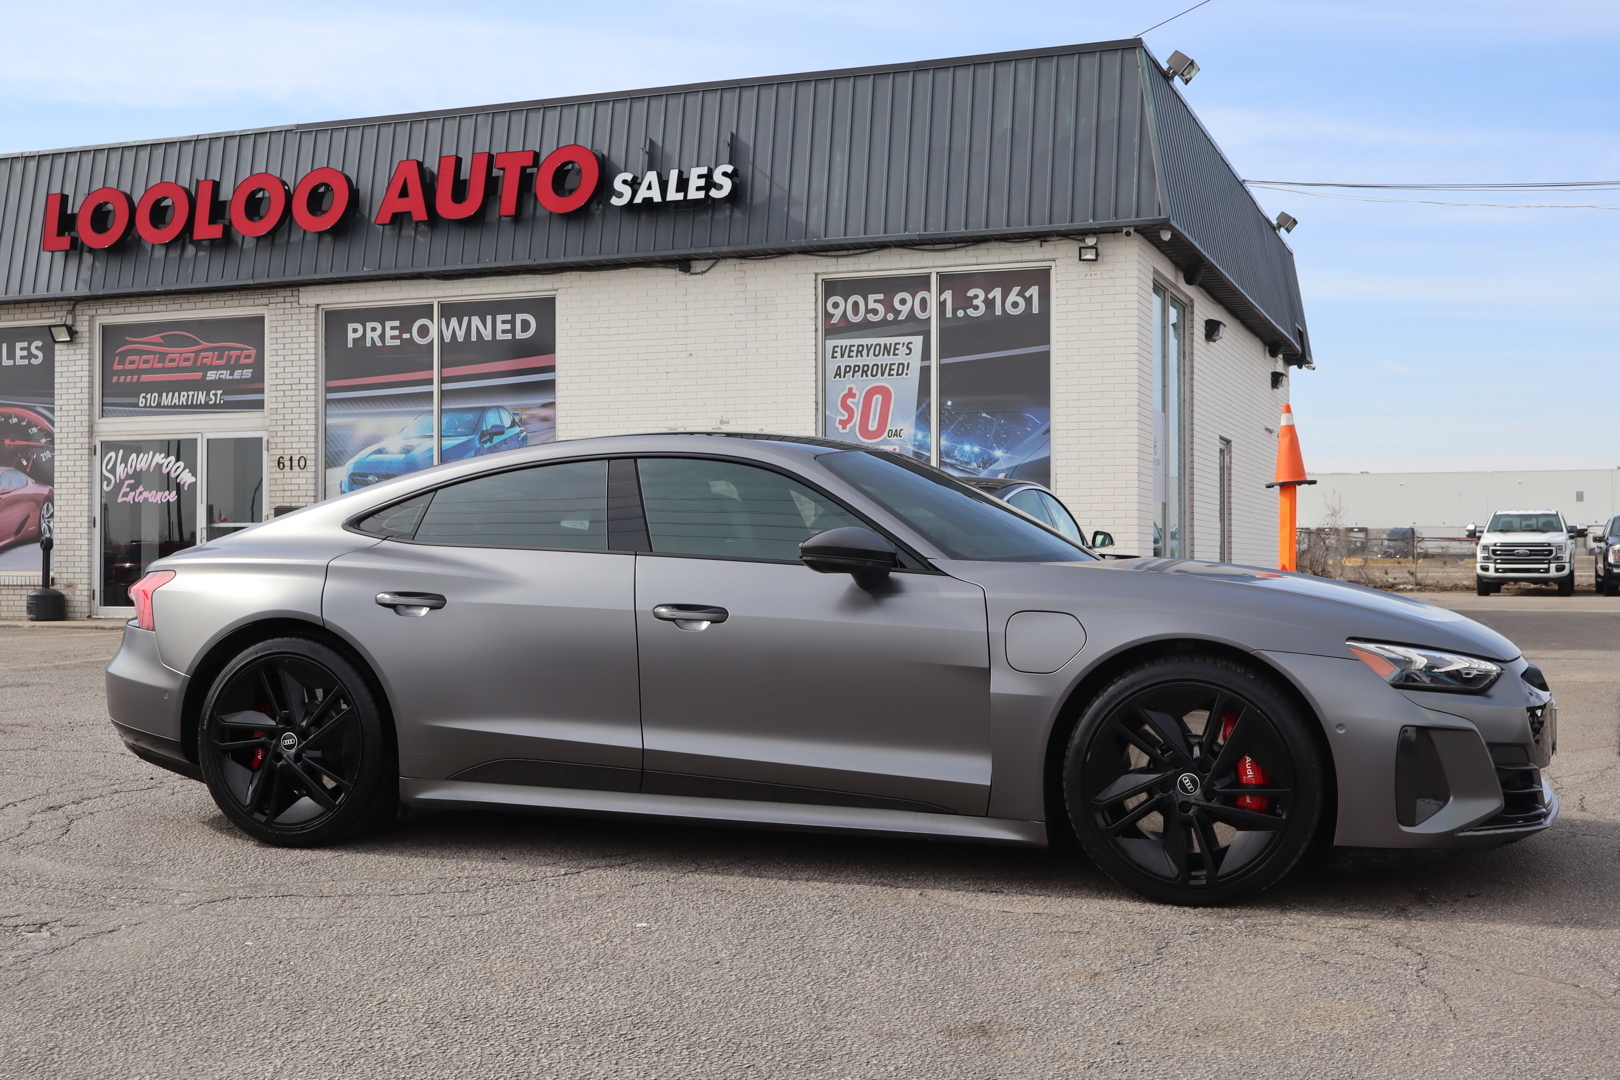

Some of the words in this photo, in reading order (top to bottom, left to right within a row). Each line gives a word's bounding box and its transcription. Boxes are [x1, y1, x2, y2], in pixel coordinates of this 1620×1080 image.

[42, 166, 354, 252] LOOLOO
[373, 144, 600, 226] AUTO
[609, 163, 736, 207] SALES
[826, 285, 1040, 323] 905.901.3161
[347, 313, 537, 348] PRE-OWNED
[2, 340, 44, 366] LES
[112, 352, 195, 371] LOOLOO
[197, 349, 257, 367] AUTO
[831, 341, 914, 360] EVERYONE'S
[206, 369, 253, 381] SALES
[833, 362, 911, 380] APPROVED!
[139, 392, 159, 407] 610
[161, 391, 206, 406] MARTIN
[209, 390, 224, 405] ST.
[838, 385, 892, 440] $0
[887, 428, 904, 438] OAC
[40, 450, 52, 462] 210
[277, 455, 307, 471] 610
[102, 449, 196, 491] Showroom
[117, 480, 178, 504] Entrance
[1245, 755, 1254, 778] Audi
